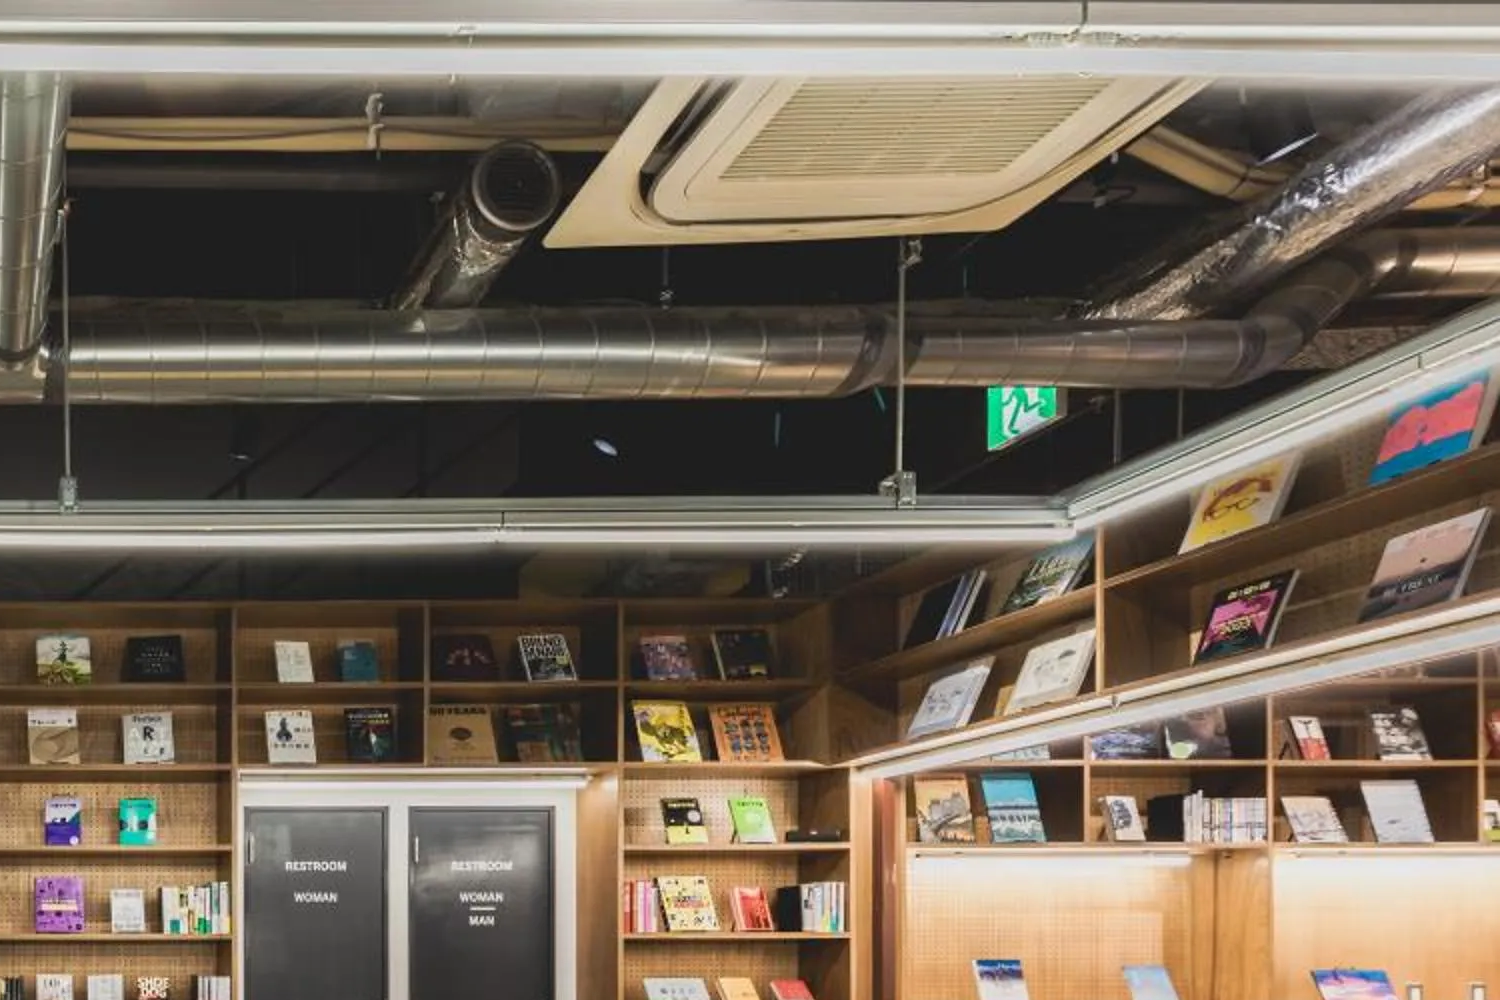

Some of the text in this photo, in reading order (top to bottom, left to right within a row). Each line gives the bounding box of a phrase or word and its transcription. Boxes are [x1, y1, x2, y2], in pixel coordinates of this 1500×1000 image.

[284, 861, 347, 872] RESTROOM
[451, 861, 513, 872] RESTROOM
[293, 892, 338, 903] WOMAN
[459, 892, 504, 903] WOMAN
[468, 915, 495, 926] MAN
[137, 977, 169, 989] SHOE
